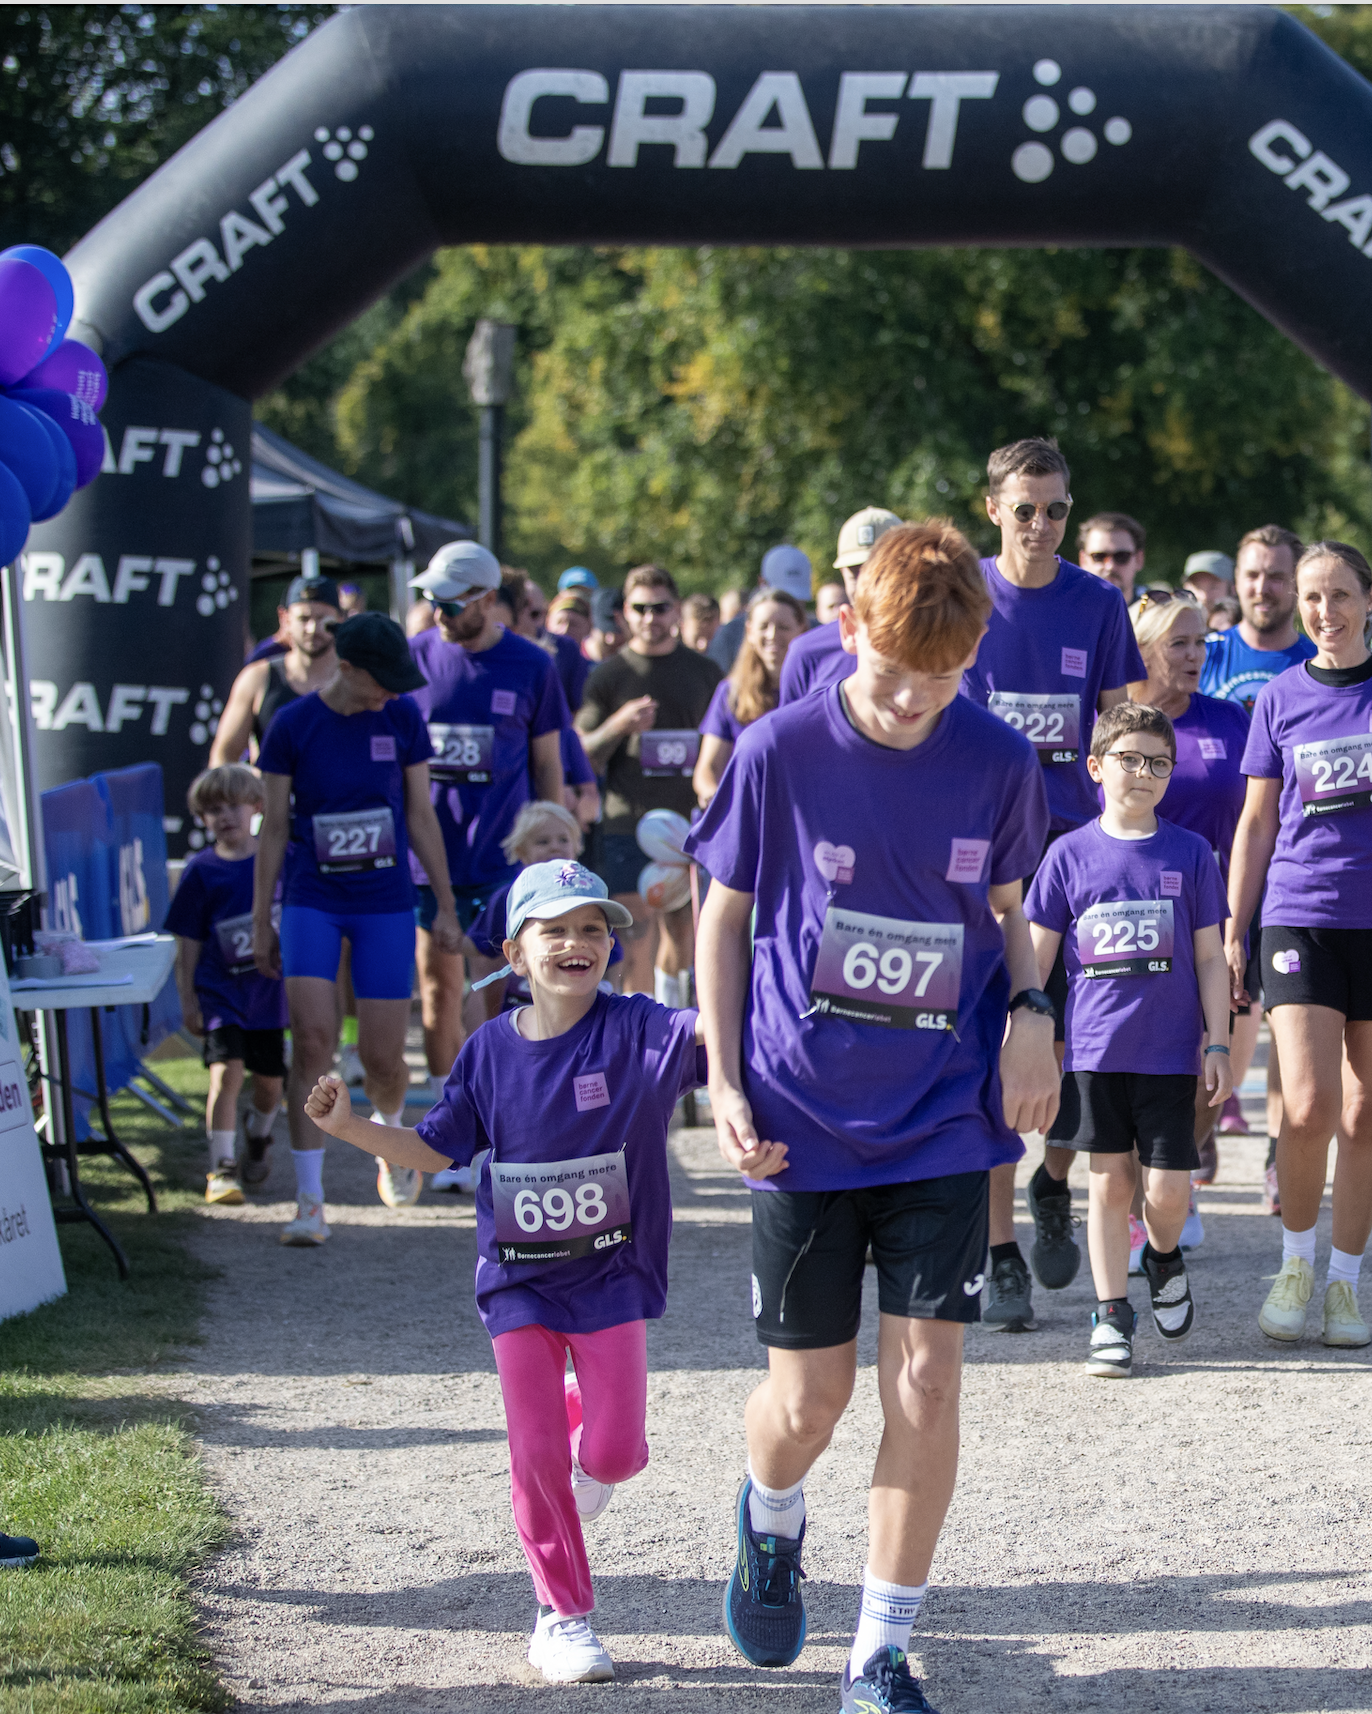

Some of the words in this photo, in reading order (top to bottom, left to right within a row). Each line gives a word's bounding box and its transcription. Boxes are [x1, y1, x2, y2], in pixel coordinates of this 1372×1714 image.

[497, 68, 999, 170] CRAFT
[1248, 118, 1372, 259] CRA
[134, 149, 320, 332] CRAFT
[21, 552, 196, 606] RAFT
[1004, 711, 1065, 742] 222
[1331, 743, 1362, 753] omgang
[1311, 753, 1372, 793] 224
[328, 825, 382, 857] 227
[1112, 909, 1145, 917] omgang
[835, 921, 864, 935] Bare
[868, 928, 883, 939] én
[887, 933, 932, 946] omgang
[1092, 920, 1159, 956] 225
[843, 942, 944, 997] 697
[580, 1086, 603, 1096] cancer
[581, 1092, 605, 1102] fonden
[499, 1174, 521, 1183] Bare
[525, 1174, 537, 1183] én
[540, 1170, 586, 1183] omgang
[588, 1164, 617, 1177] mere
[514, 1182, 608, 1233] 698
